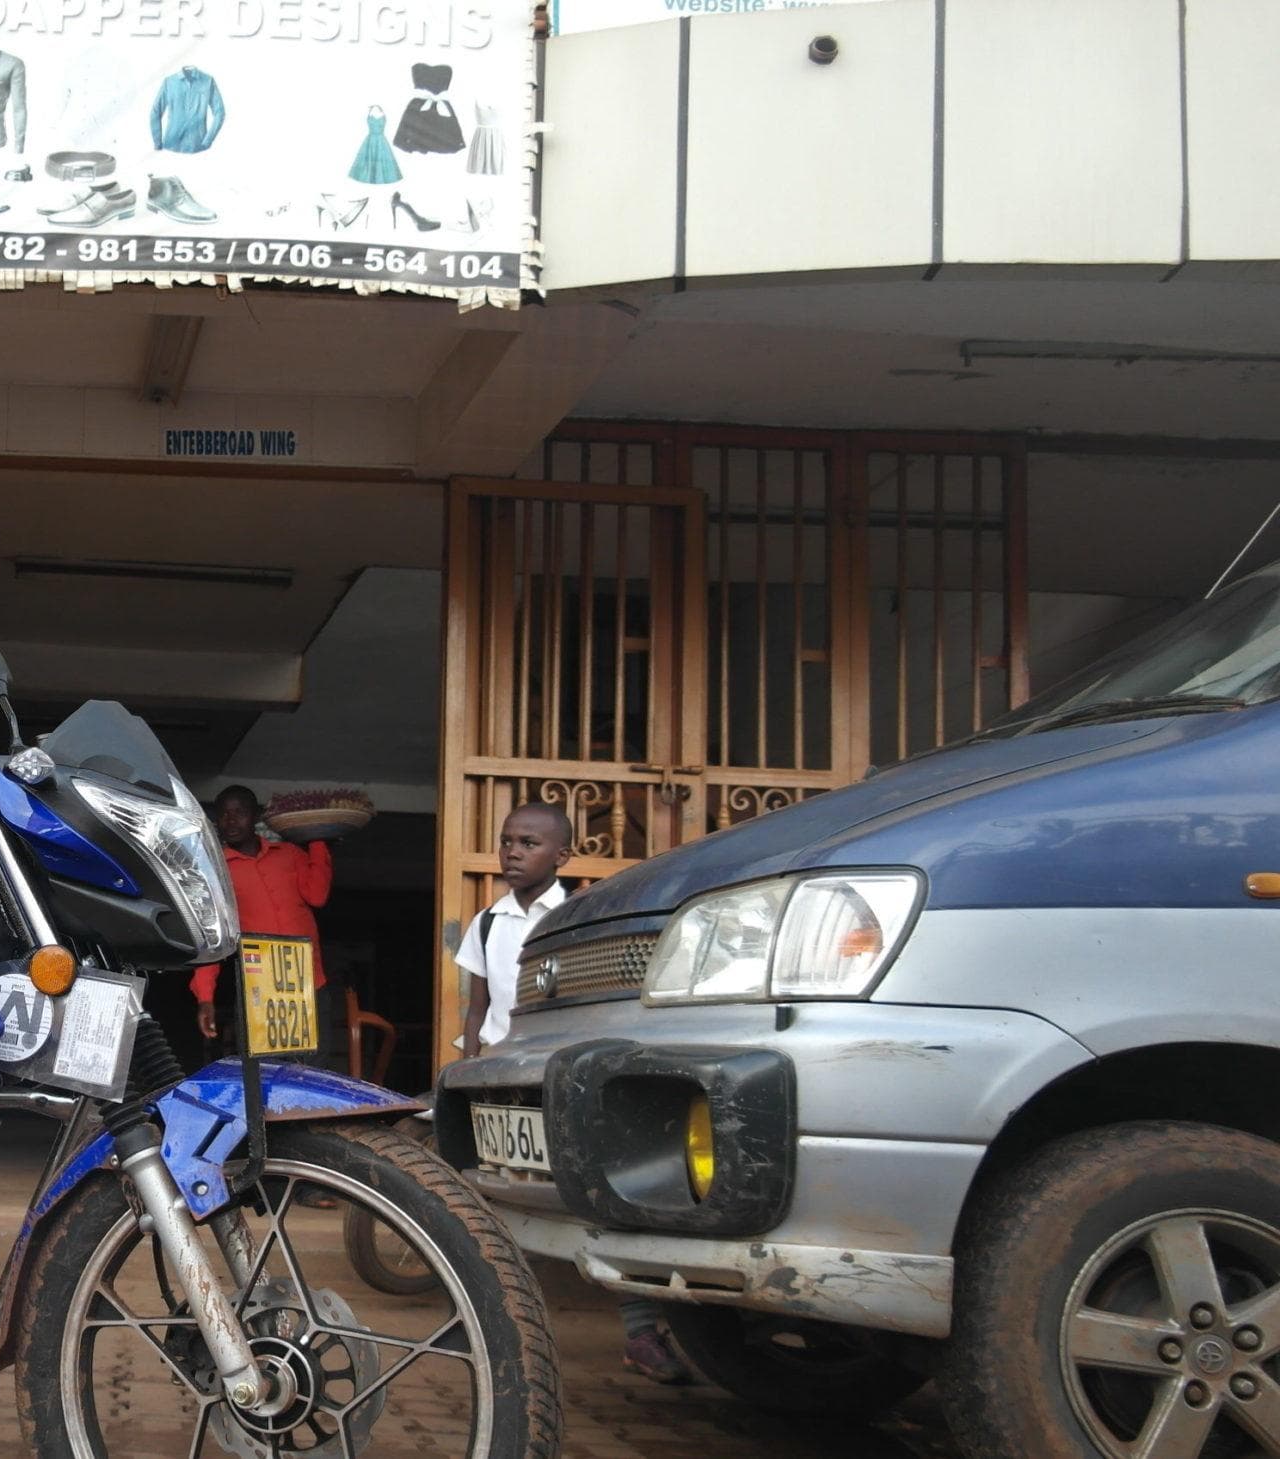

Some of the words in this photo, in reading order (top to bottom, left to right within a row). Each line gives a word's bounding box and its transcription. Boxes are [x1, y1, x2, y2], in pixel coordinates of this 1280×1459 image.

[228, 0, 496, 51] DESIGNS
[77, 238, 138, 263] 981
[152, 240, 217, 264] 553
[246, 241, 332, 269] 0706
[364, 248, 428, 275] 564
[440, 254, 503, 280] 104
[166, 430, 255, 456] ENTEBBEROAD
[260, 430, 296, 456] WING
[266, 998, 311, 1049] 882A
